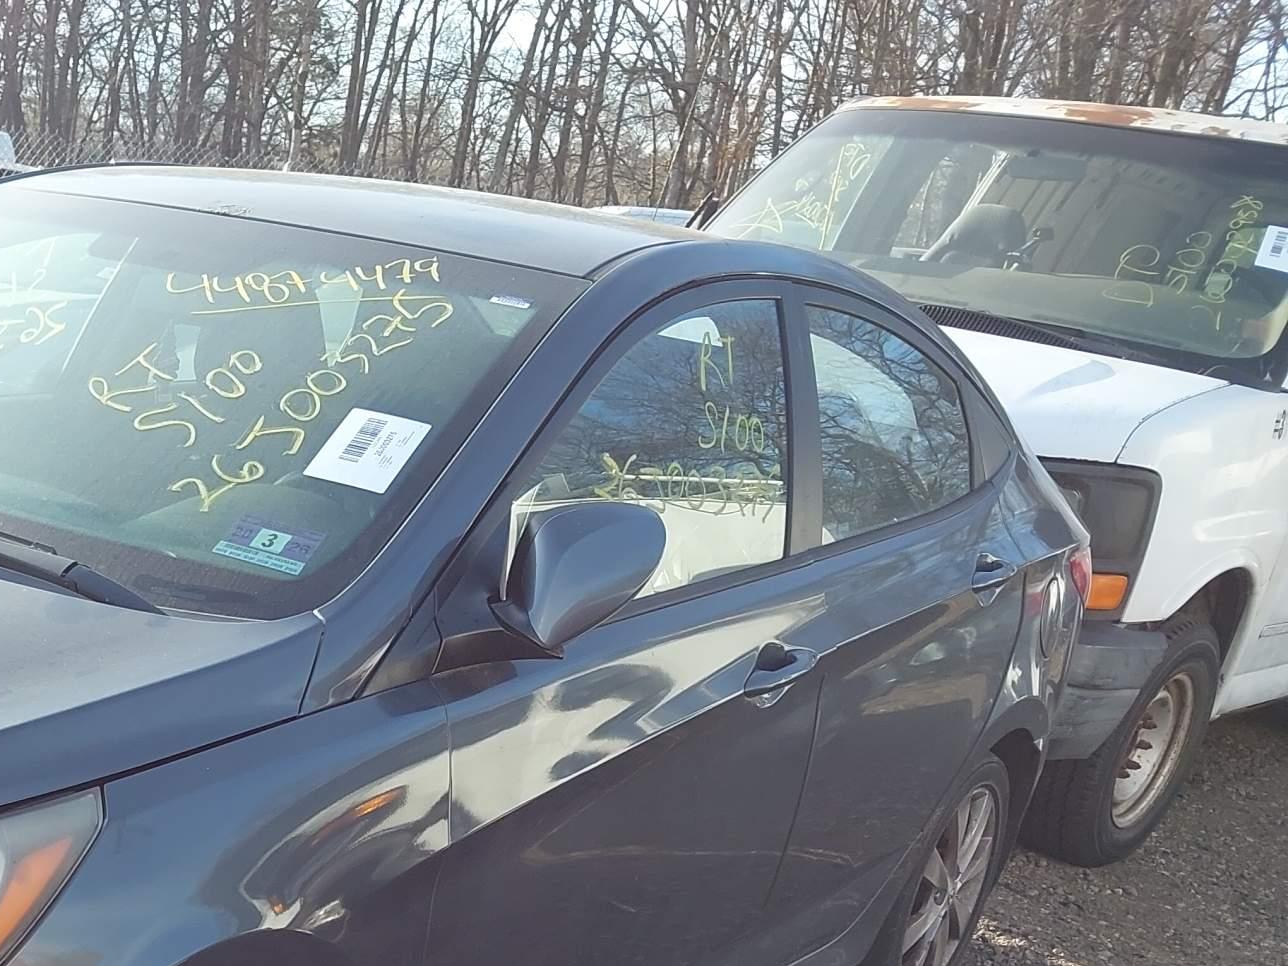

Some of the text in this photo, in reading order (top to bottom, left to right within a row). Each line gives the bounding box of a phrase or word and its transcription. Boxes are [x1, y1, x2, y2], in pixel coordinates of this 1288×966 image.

[166, 255, 440, 303] 44874479
[88, 343, 174, 412] RT
[698, 331, 735, 391] RT
[133, 349, 263, 448] S100
[698, 401, 764, 453] S100
[260, 533, 278, 548] 3
